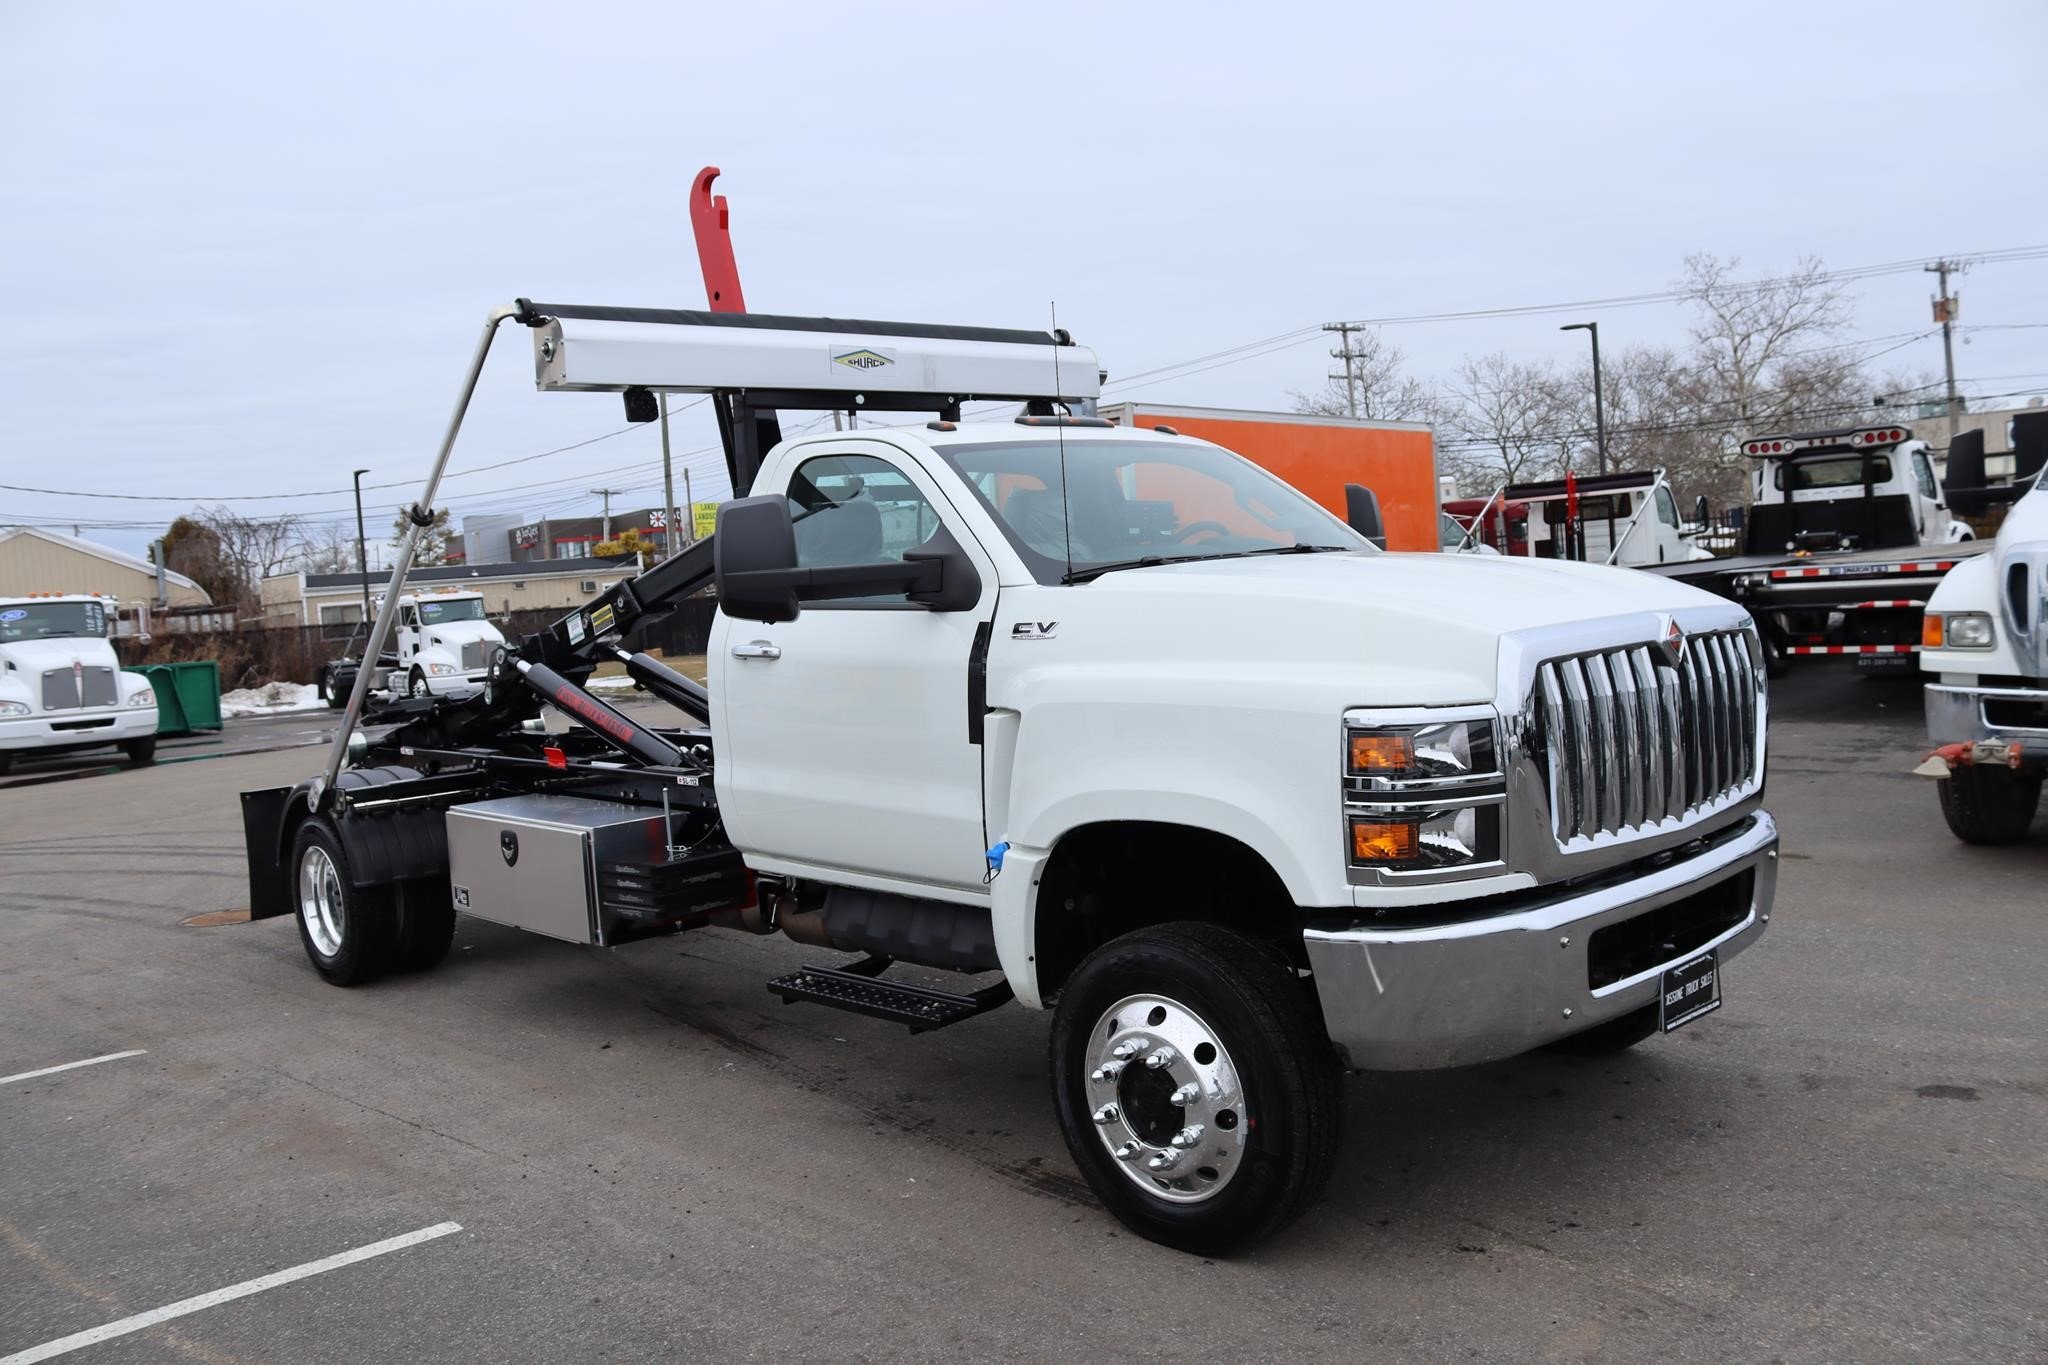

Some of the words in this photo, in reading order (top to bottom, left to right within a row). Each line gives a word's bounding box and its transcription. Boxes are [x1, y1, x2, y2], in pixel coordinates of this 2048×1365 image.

[847, 357, 885, 369] SHURCO
[1012, 621, 1057, 634] CV
[1685, 978, 1700, 997] TRUCK
[1700, 970, 1713, 989] SALES
